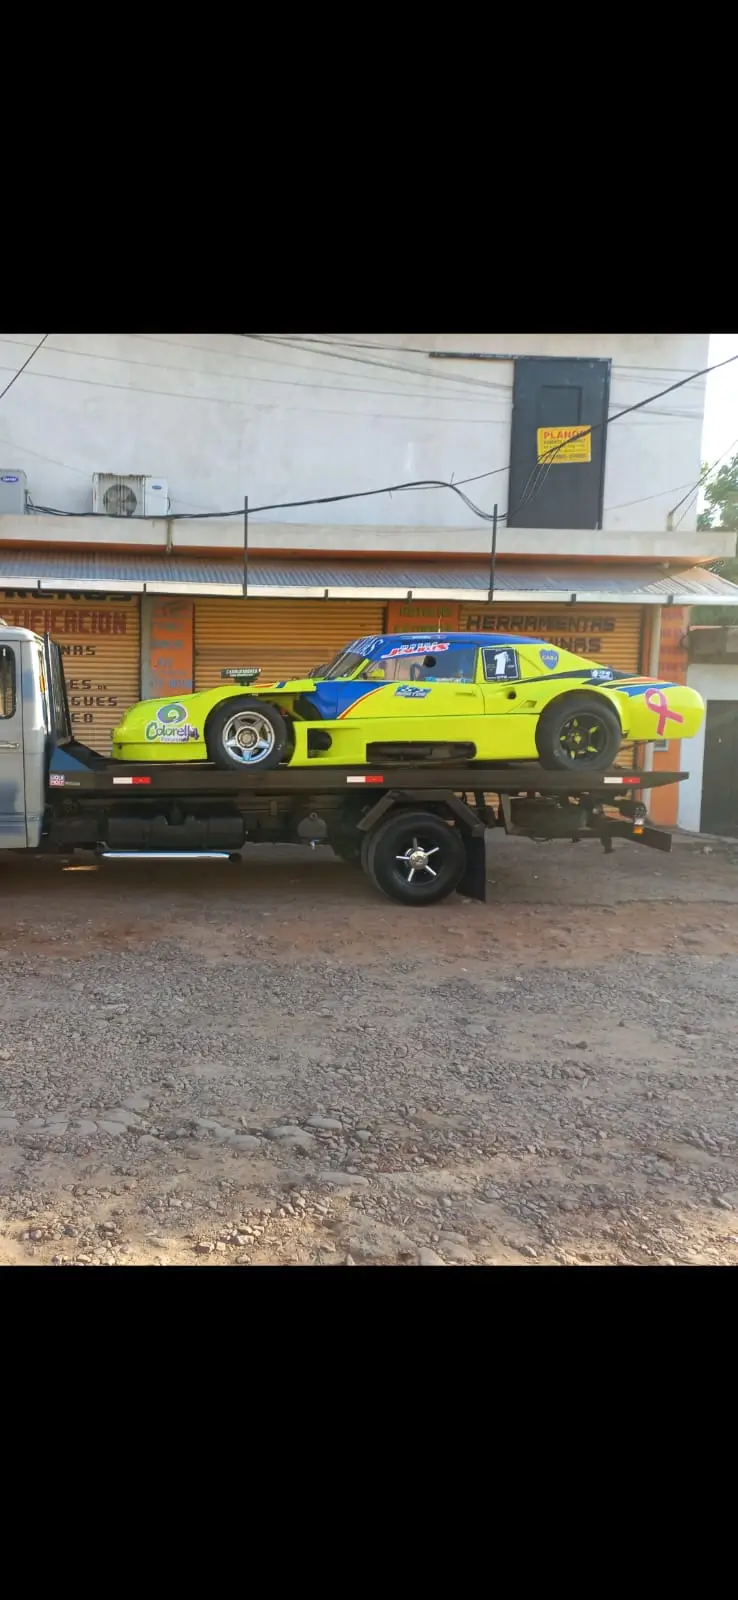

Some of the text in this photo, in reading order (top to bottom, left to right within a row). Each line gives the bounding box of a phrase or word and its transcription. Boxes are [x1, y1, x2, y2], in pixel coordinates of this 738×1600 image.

[467, 615, 616, 632] HERRAMIENTAS
[494, 651, 508, 675] 1
[71, 696, 118, 707] GUES
